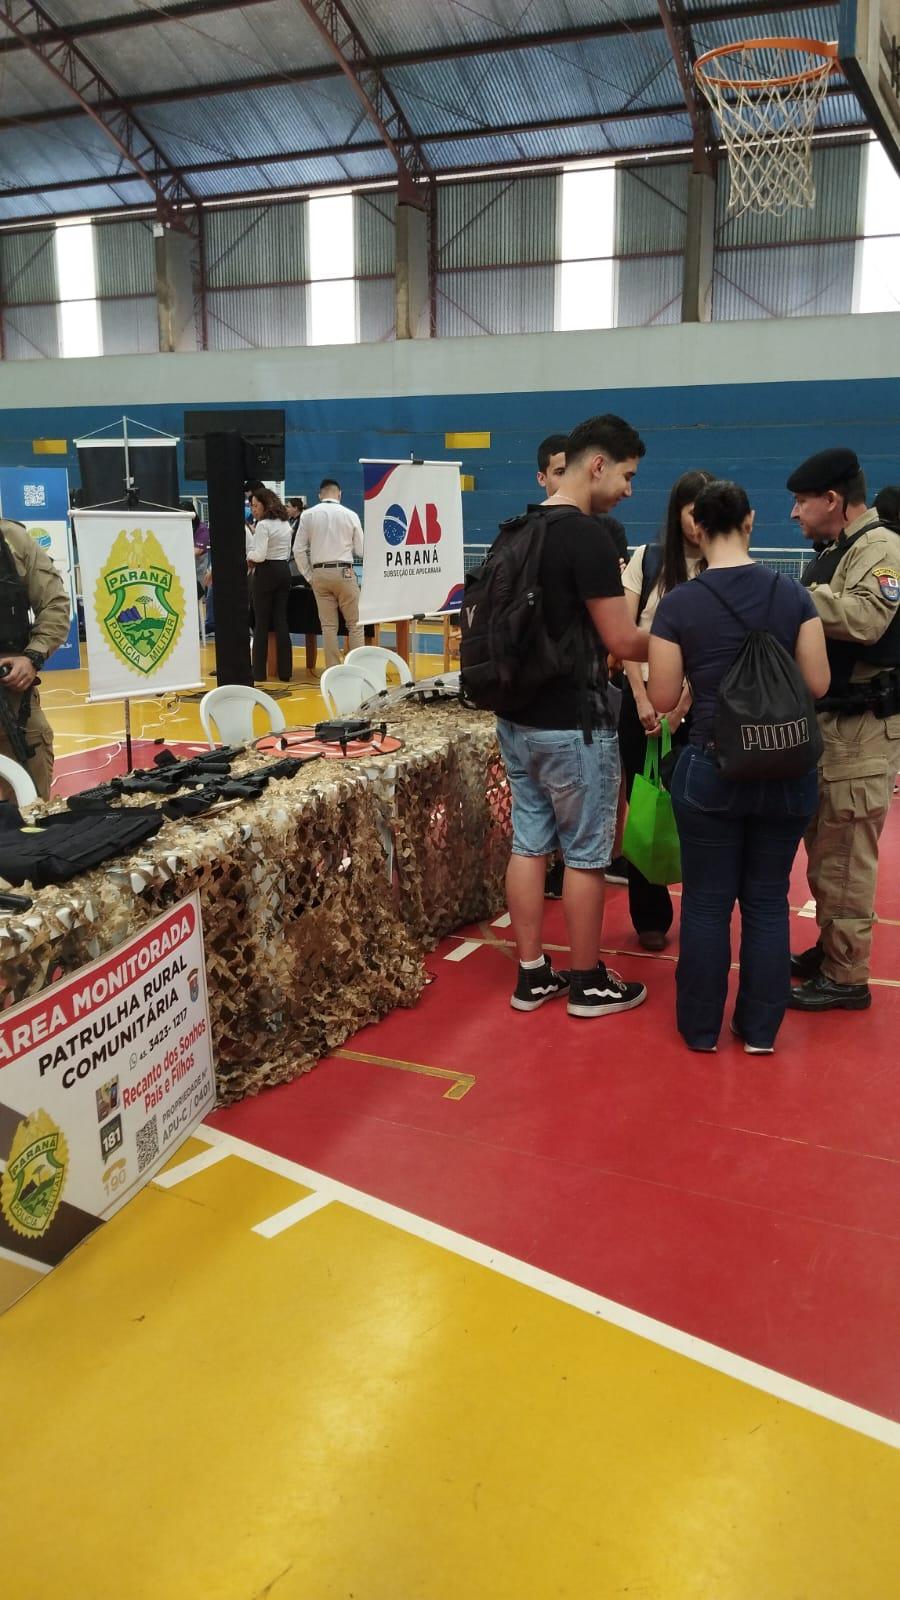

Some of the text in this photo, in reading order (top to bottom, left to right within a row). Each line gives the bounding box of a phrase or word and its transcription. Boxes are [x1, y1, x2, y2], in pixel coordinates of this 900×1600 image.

[383, 503, 442, 546] OAB
[386, 545, 439, 567] PARANÁ
[408, 568, 416, 576] DE
[109, 570, 169, 588] PARANÁ
[149, 617, 175, 661] MILITAR
[740, 717, 810, 750] PUMA
[72, 916, 191, 1017] MONITORADA
[38, 955, 188, 1077] PATRULHA RURAL
[61, 987, 180, 1089] COMUNITÁRIA
[122, 1018, 206, 1110] Recanto dos Sonhos
[144, 1052, 195, 1115] Pais e Filhos
[162, 1074, 201, 1123] PROPRIEDADE
[102, 1127, 121, 1152] 181
[162, 1107, 187, 1144] APU-C
[11, 1136, 57, 1176] PARANÁ
[103, 1168, 127, 1197] 190
